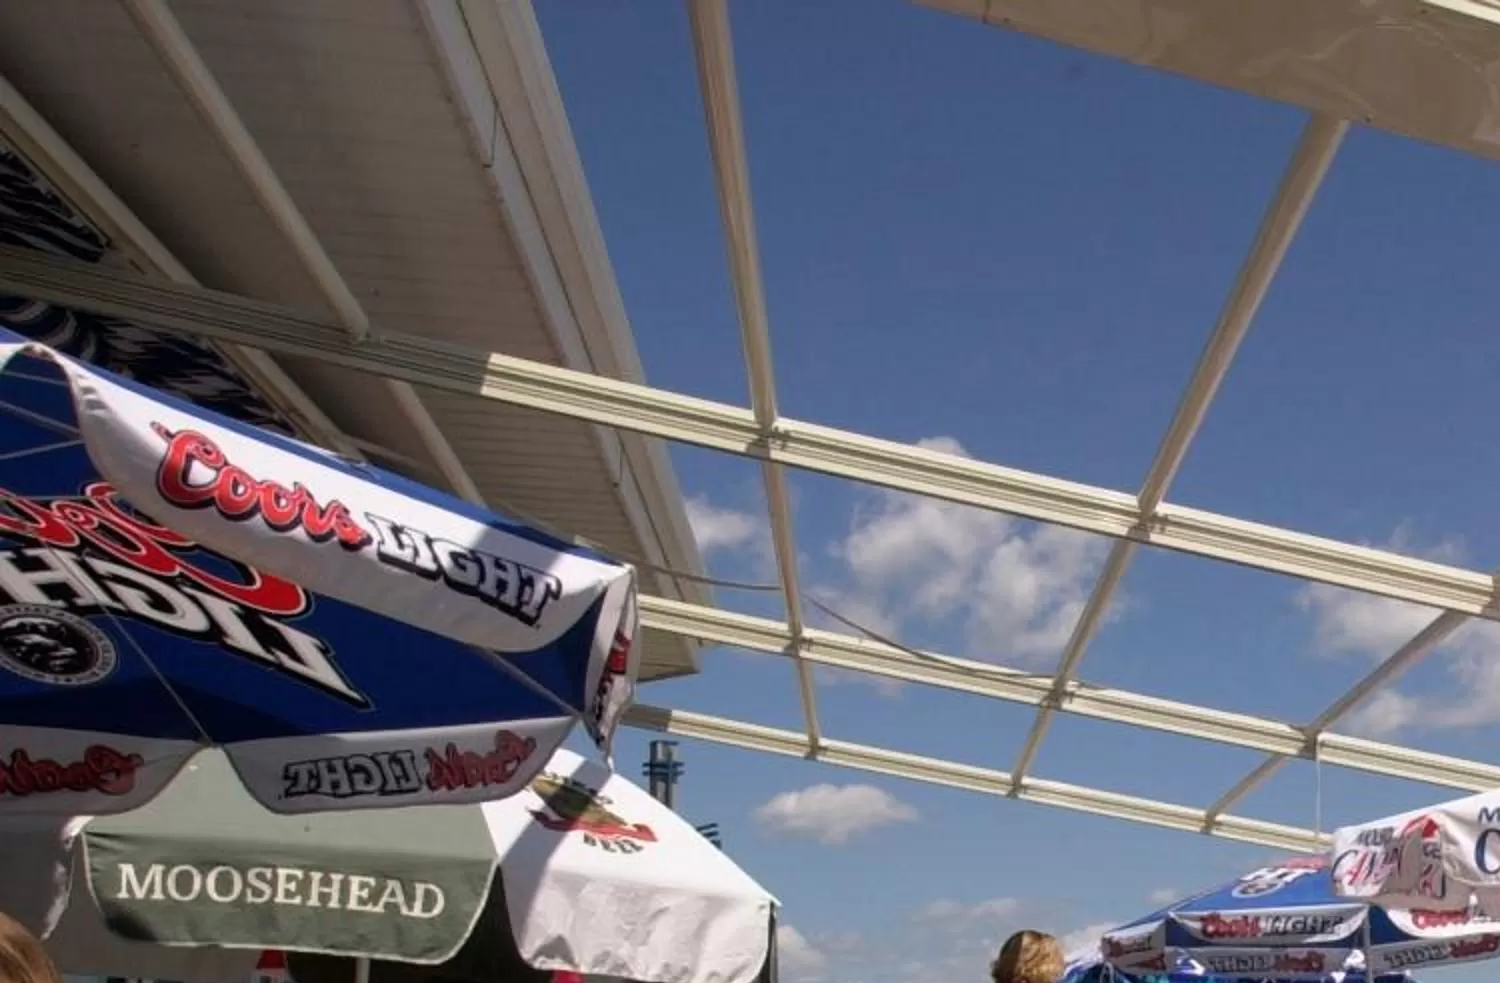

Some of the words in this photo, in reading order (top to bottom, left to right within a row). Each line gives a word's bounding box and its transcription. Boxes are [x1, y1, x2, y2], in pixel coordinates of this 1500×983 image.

[150, 420, 374, 552] Coors
[363, 511, 563, 628] LIGHT
[116, 863, 446, 919] MOOSEHEAD
